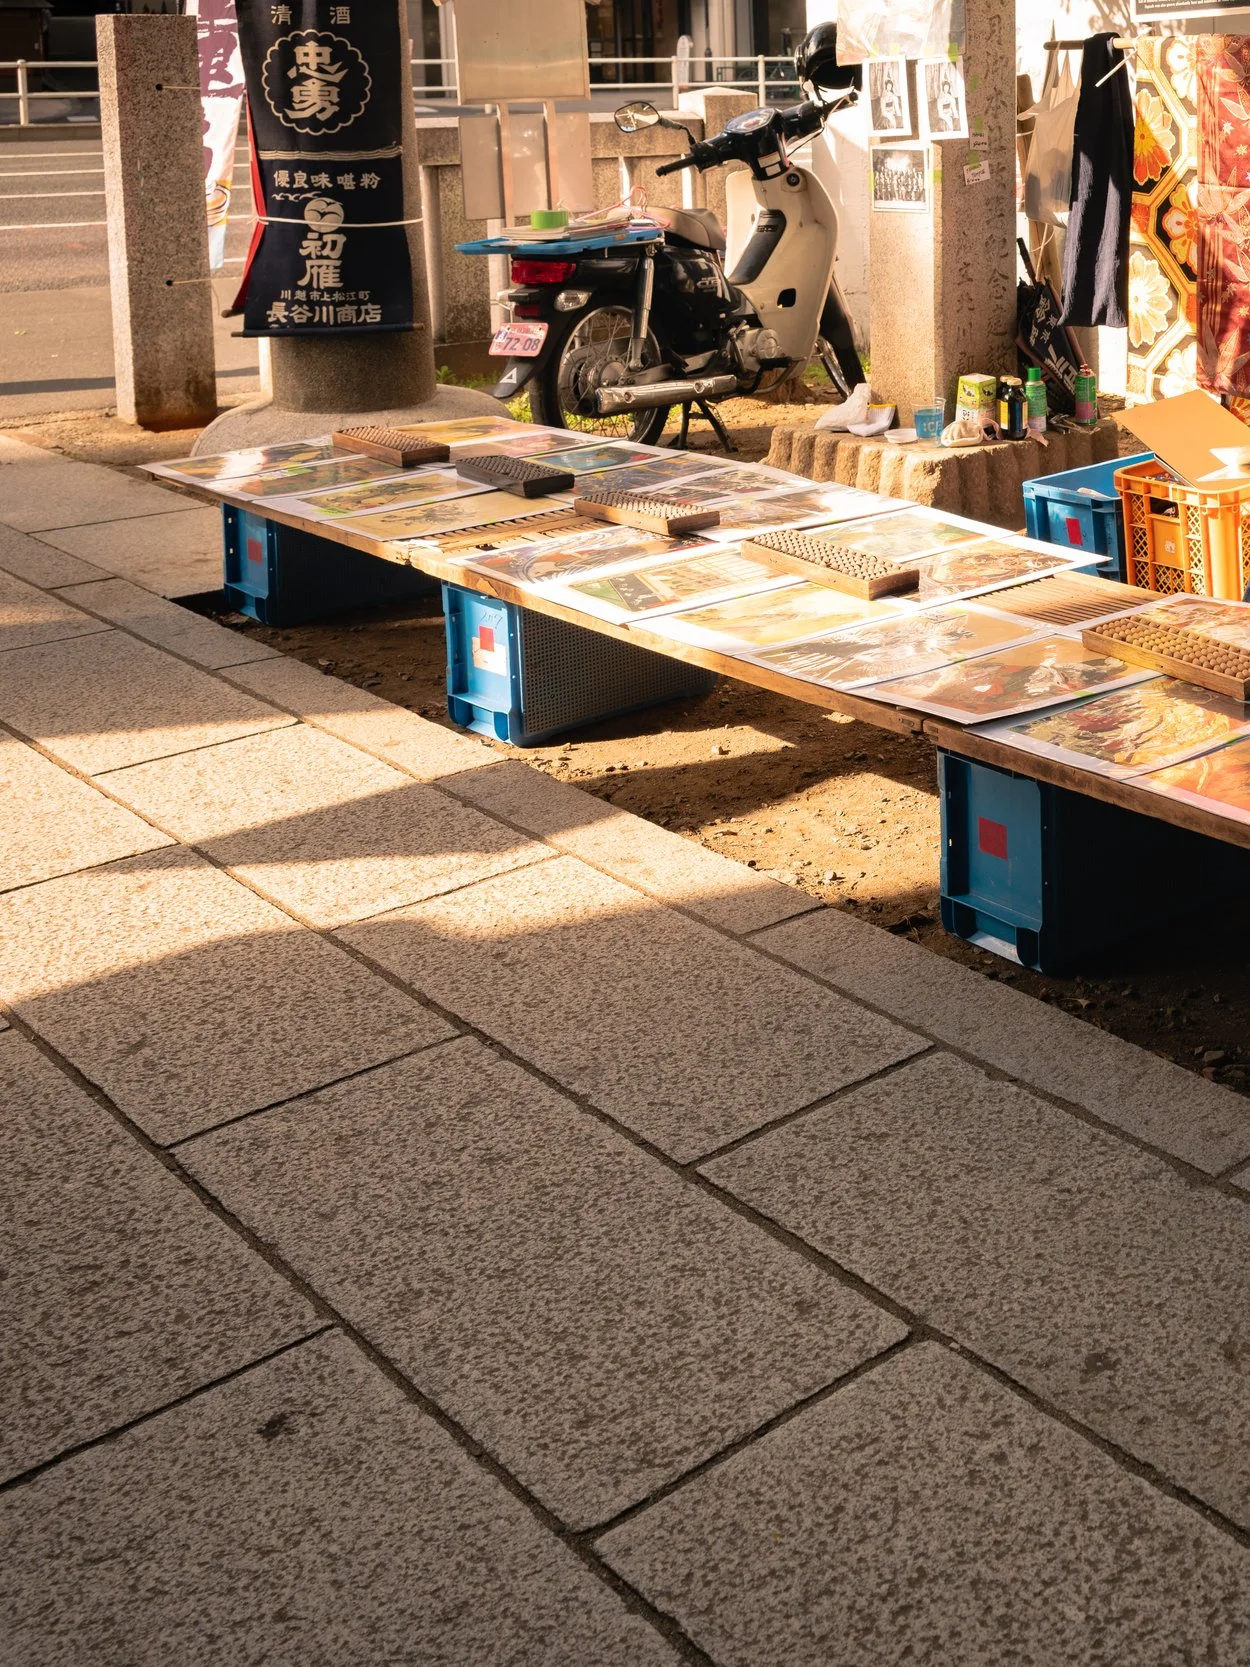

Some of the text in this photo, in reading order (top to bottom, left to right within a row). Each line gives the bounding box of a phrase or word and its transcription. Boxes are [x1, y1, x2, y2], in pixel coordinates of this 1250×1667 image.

[297, 232, 347, 290] 初雁
[266, 301, 382, 325] 長谷川商店
